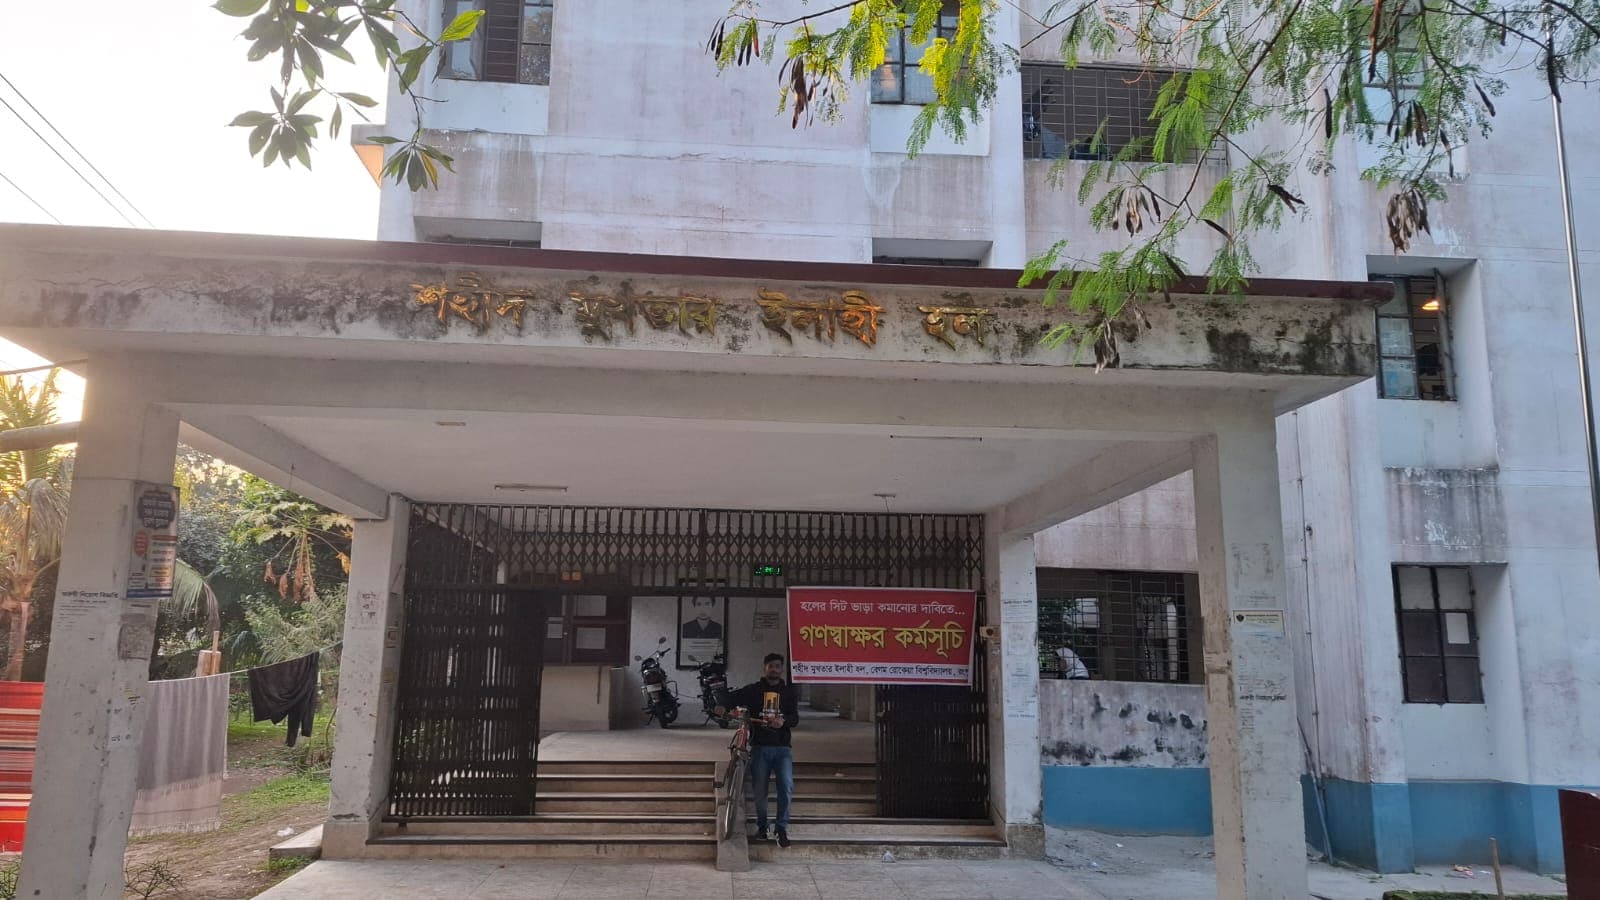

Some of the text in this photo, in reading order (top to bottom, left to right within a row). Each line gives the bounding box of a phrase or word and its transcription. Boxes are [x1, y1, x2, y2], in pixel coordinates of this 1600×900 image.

[409, 271, 535, 334] শহীদ
[756, 286, 887, 349] ইলাহী
[917, 304, 998, 350] হল
[799, 601, 826, 612] হলের
[830, 599, 848, 612] সিট
[851, 602, 874, 615] ভাড়া
[877, 602, 917, 614] কমানোর
[799, 619, 966, 657] গণস্বাক্ষর কর্মসূচি
